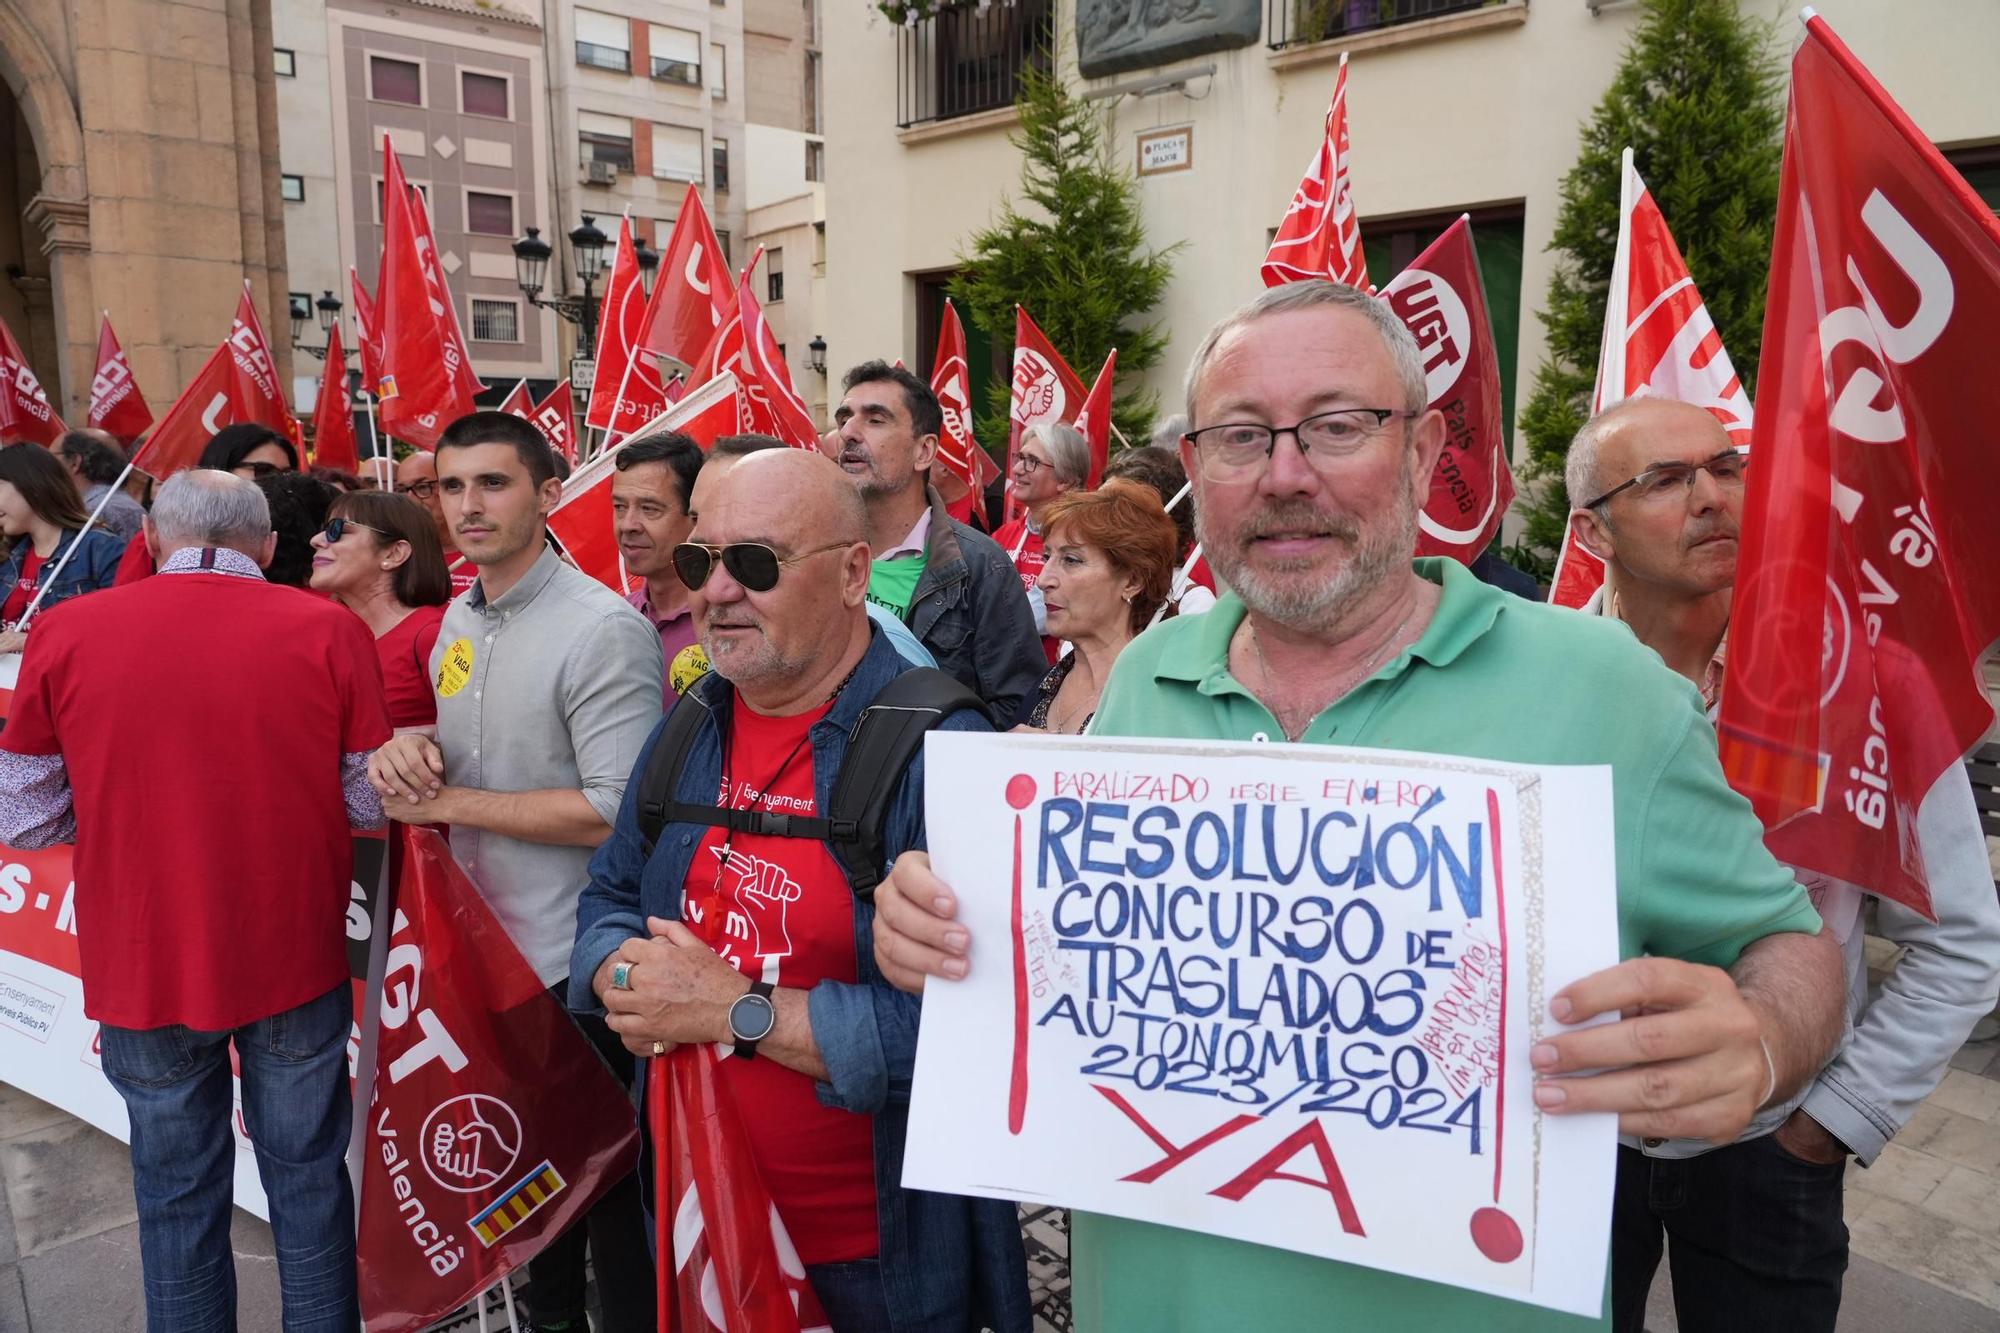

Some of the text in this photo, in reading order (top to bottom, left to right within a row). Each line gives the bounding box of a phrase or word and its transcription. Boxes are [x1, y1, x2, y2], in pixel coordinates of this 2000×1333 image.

[453, 654, 470, 675] VAGA
[691, 659, 709, 672] VAG
[1055, 772, 1208, 803] PARALIZADO
[1322, 778, 1434, 807] ENERO
[1037, 786, 1482, 919] RESOLUCIÓN
[1053, 882, 1385, 964] CONCURSO
[1406, 930, 1456, 969] DE
[1058, 939, 1428, 1036] TRASLADOS
[1036, 994, 1429, 1089] AUTONÓMICO
[1081, 1044, 1488, 1155] 2023/2024
[376, 1106, 465, 1279] Valencià
[1090, 1083, 1367, 1238] YA
